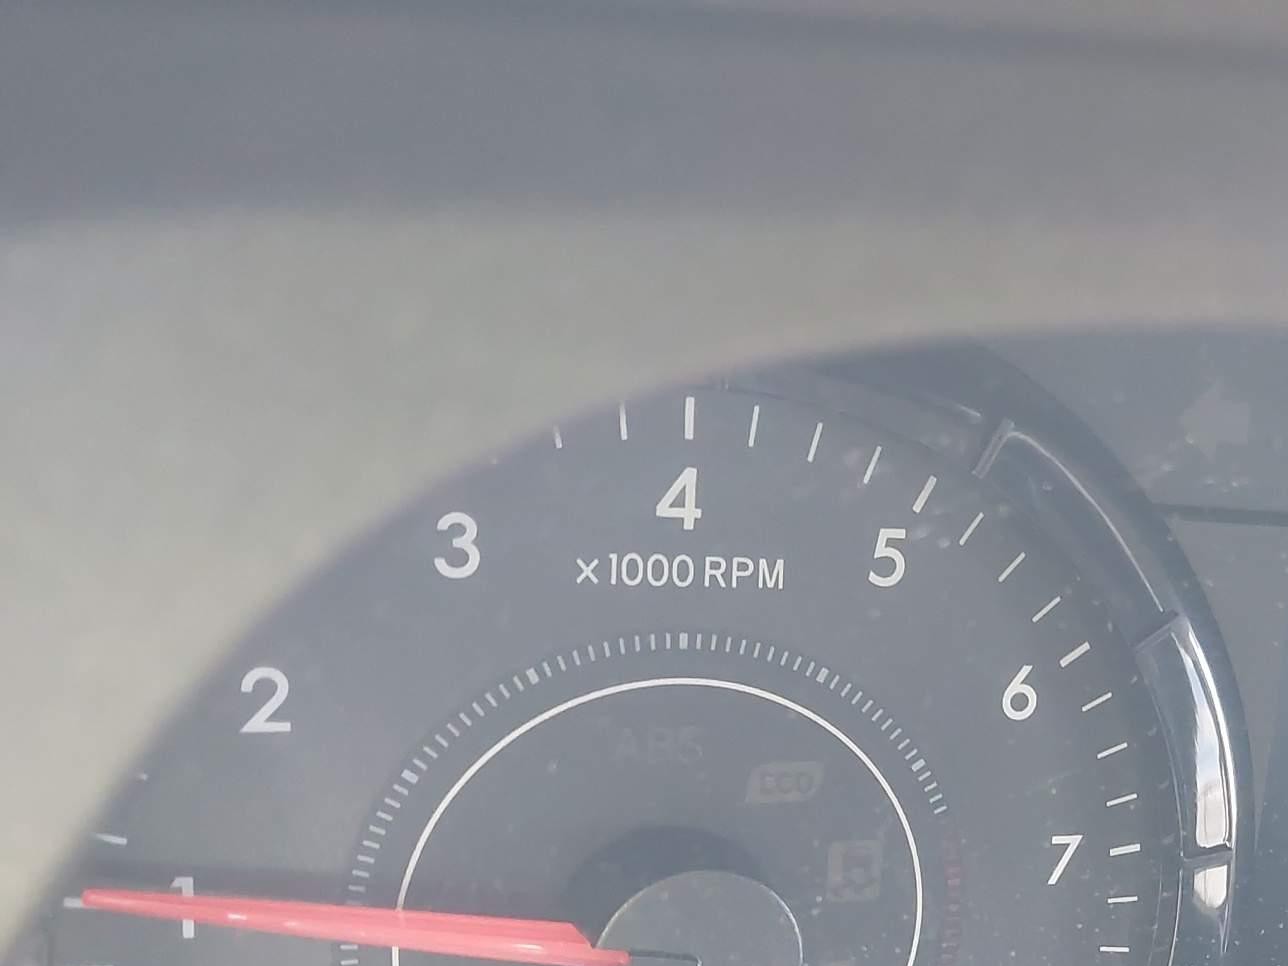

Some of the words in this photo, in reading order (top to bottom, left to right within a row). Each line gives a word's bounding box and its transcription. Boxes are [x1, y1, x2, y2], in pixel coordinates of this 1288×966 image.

[656, 466, 703, 530] 4
[433, 511, 480, 579] 3
[703, 555, 785, 590] RPM
[867, 527, 907, 587] 5
[239, 667, 292, 734] 2
[1001, 664, 1038, 722] 6
[1047, 834, 1084, 885] 7
